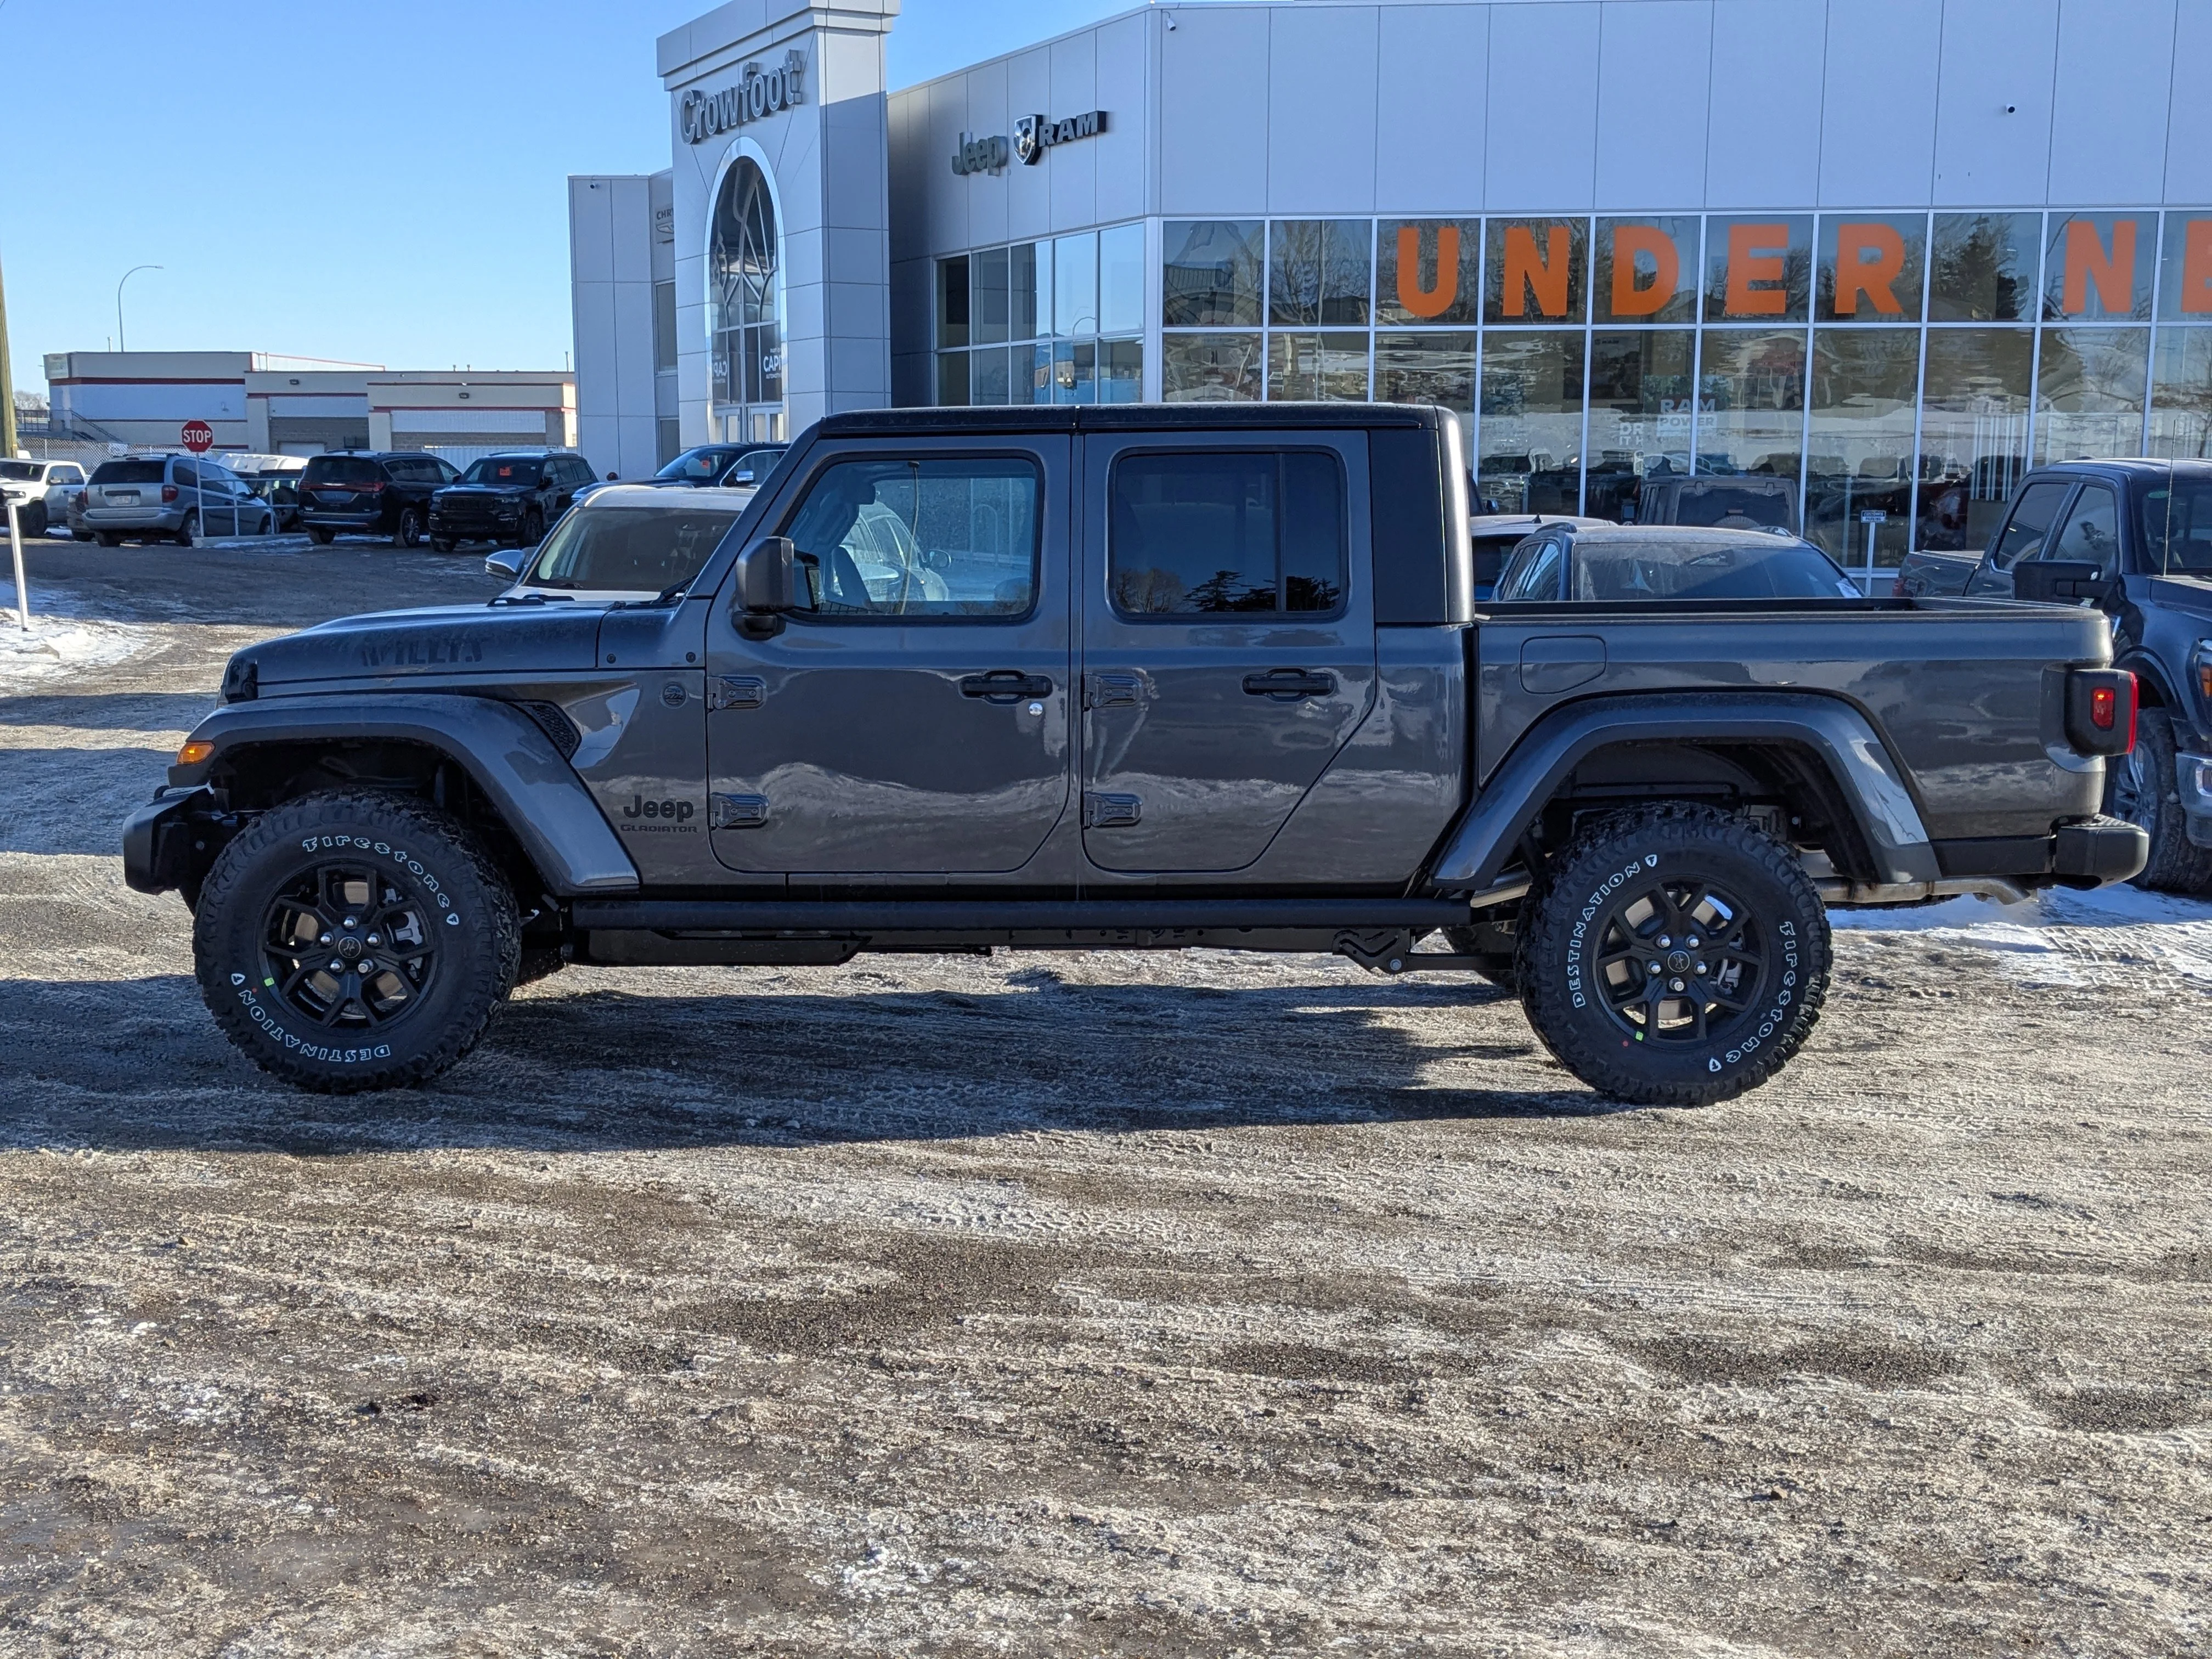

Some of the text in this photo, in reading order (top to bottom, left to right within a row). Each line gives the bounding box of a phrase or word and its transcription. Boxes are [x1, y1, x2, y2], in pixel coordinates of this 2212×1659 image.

[680, 49, 802, 145] Crowfoot
[1039, 111, 1106, 148] RAM
[952, 132, 1007, 176] Jeep
[657, 208, 673, 220] CHR
[1397, 223, 1905, 318] UNDER
[1661, 399, 1715, 413] RAM
[183, 430, 211, 443] STOP
[620, 825, 698, 833] GLADIATOR
[623, 795, 693, 823] Jeep
[302, 836, 450, 908] Firestone
[1568, 862, 1640, 1008] DESTINATION
[1725, 922, 1797, 1063] Firestone
[238, 990, 391, 1062] DESTINATION
